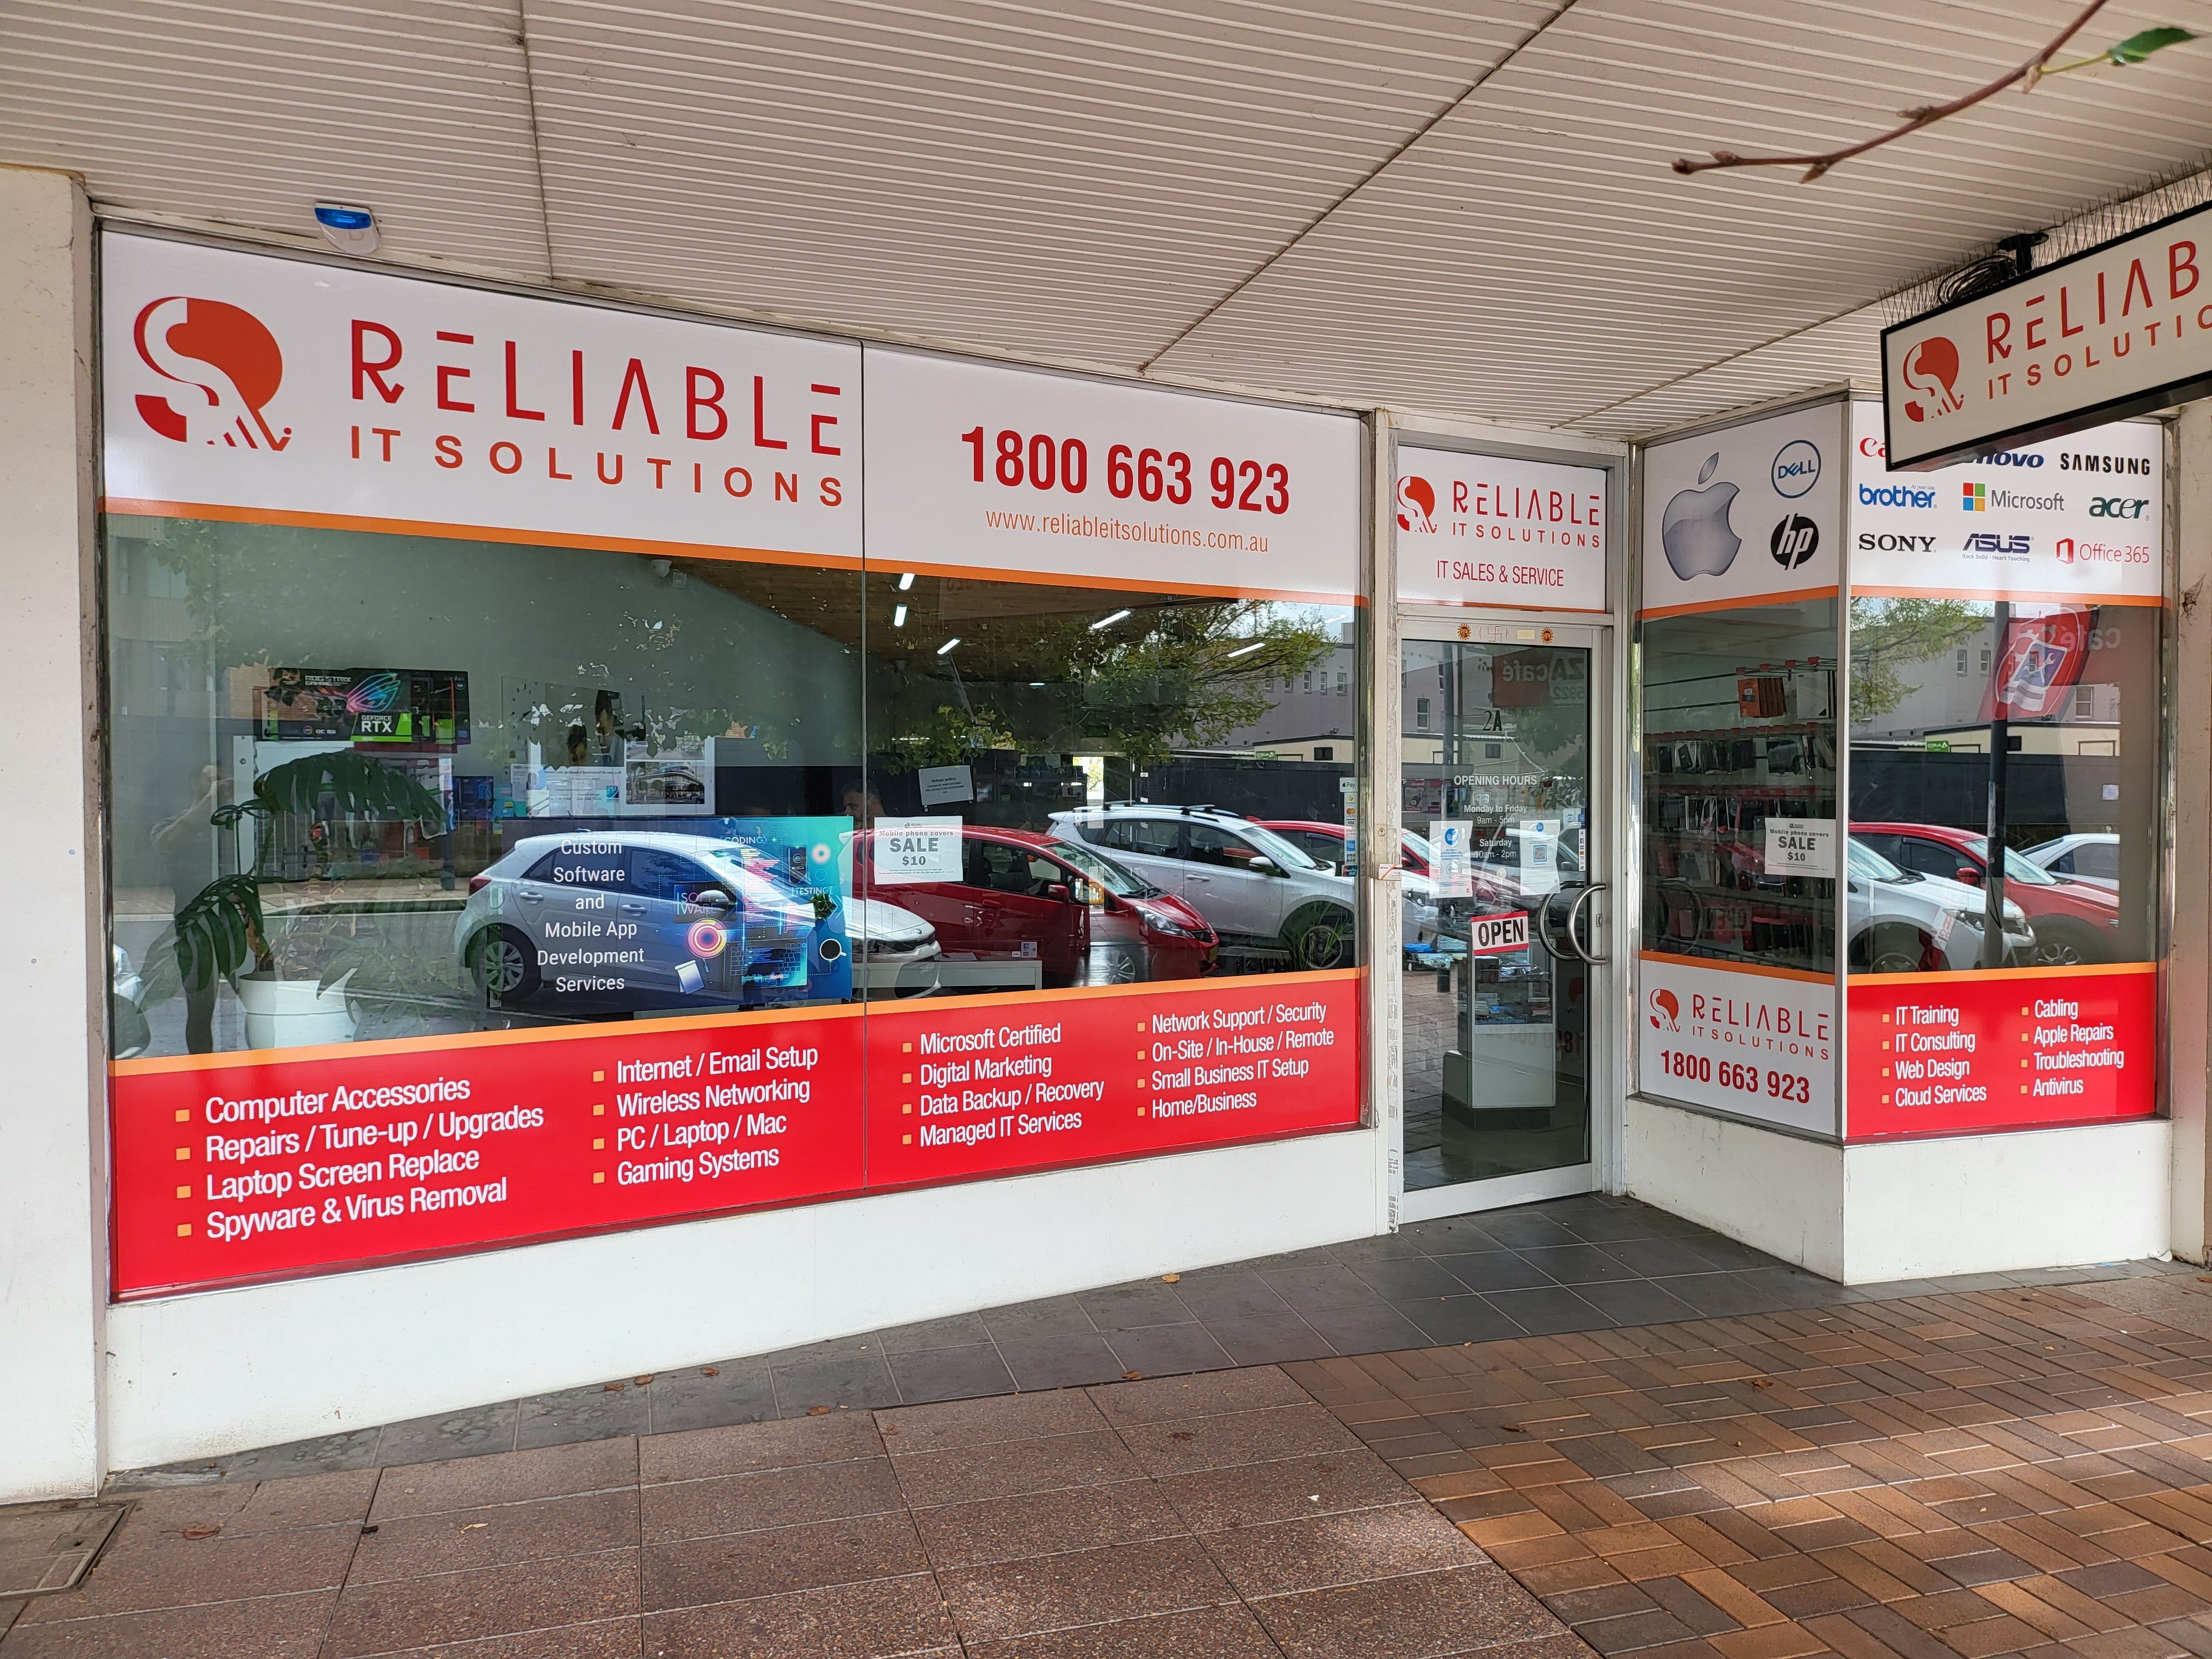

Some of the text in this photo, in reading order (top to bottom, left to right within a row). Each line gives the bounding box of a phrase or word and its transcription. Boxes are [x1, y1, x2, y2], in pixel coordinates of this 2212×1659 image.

[351, 318, 842, 456] RELIABLE
[1989, 373, 2012, 399] IT
[352, 425, 843, 507] IT SOLUTIONS
[961, 425, 1290, 515] 1800 663 923
[1778, 460, 1815, 479] DELL
[2060, 452, 2150, 476] SAMSUNG
[1453, 481, 1600, 526] RELIABLE
[1859, 483, 1935, 508] brother
[1991, 489, 2064, 512] Microsoft
[2089, 496, 2149, 519] acer
[985, 509, 1269, 553] www.reliableitsolutions.com.au
[1453, 522, 1600, 548] IT SOLUTIONS
[1776, 513, 1814, 570] hp
[1859, 533, 1934, 552] SONY
[1963, 534, 2030, 554] ASUS
[2079, 543, 2150, 564] Office 365
[1437, 560, 1564, 587] IT SALES & SERVICE
[361, 721, 393, 733] RTX
[1482, 710, 1502, 731] 2A
[1454, 775, 1537, 786] OPENING HOURS
[1464, 805, 1494, 814] Monday
[1505, 805, 1527, 814] Friday
[1499, 817, 1515, 825] 5pm
[561, 839, 622, 855] Custom
[724, 836, 764, 844] CODING
[890, 838, 938, 852] SALE
[1479, 839, 1512, 847] Saturday
[1778, 836, 1815, 851] SALE
[902, 855, 926, 866] $10
[1501, 851, 1516, 859] 2pm
[1787, 852, 1805, 861] $10
[554, 867, 625, 883] Software
[576, 894, 605, 910] and
[795, 886, 830, 895] TESTING
[545, 920, 638, 939] Mobile App
[1478, 919, 1523, 946] OPEN
[538, 948, 644, 966] Development
[556, 975, 625, 992] Services
[1152, 1015, 1211, 1035] Network
[1213, 1006, 1265, 1031] Support
[1276, 1001, 1327, 1025] Security
[1693, 994, 1829, 1041] RELIABLE
[1896, 1005, 1959, 1027] IT Training
[2034, 1000, 2078, 1020] Cabling
[920, 1022, 1061, 1055] Microsoft Certified
[1152, 1039, 1204, 1062] On-Site
[1215, 1036, 1274, 1057] In-House
[1286, 1028, 1334, 1050] Remote
[1692, 1026, 1829, 1060] IT SOLUTIONS
[1896, 1031, 1975, 1052] IT Consulting
[2034, 1022, 2114, 1047] Apple Repairs
[617, 1056, 692, 1083] Internet
[709, 1048, 760, 1074] Email
[766, 1046, 817, 1070] Setup
[920, 1055, 1052, 1087] Digital Marketing
[1895, 1058, 1970, 1080] Web Design
[2034, 1048, 2124, 1071] Troubleshooting
[1152, 1058, 1310, 1091] Small Business IT Setup
[1661, 1050, 1810, 1104] 1800 663 923
[617, 1080, 810, 1117] Wireless Networking
[920, 1093, 958, 1117] Data
[962, 1088, 1020, 1112] Backup
[1036, 1078, 1104, 1103] Recovery
[1895, 1085, 1987, 1107] Cloud Services
[2033, 1077, 2084, 1097] Antivirus
[205, 1077, 470, 1124] Computer Accessories
[1152, 1090, 1257, 1119] Home/Business
[207, 1130, 300, 1164] Repairs
[320, 1120, 418, 1150] Tune-up
[439, 1105, 544, 1140] Upgrades
[617, 1125, 645, 1151] PC
[664, 1120, 729, 1148] Laptop
[747, 1113, 786, 1136] Mac
[920, 1111, 1082, 1147] Managed IT Services
[207, 1148, 479, 1202] Laptop Screen Replace
[617, 1148, 779, 1186] Gaming Systems
[207, 1177, 507, 1241] Spyware & Virus Removal
